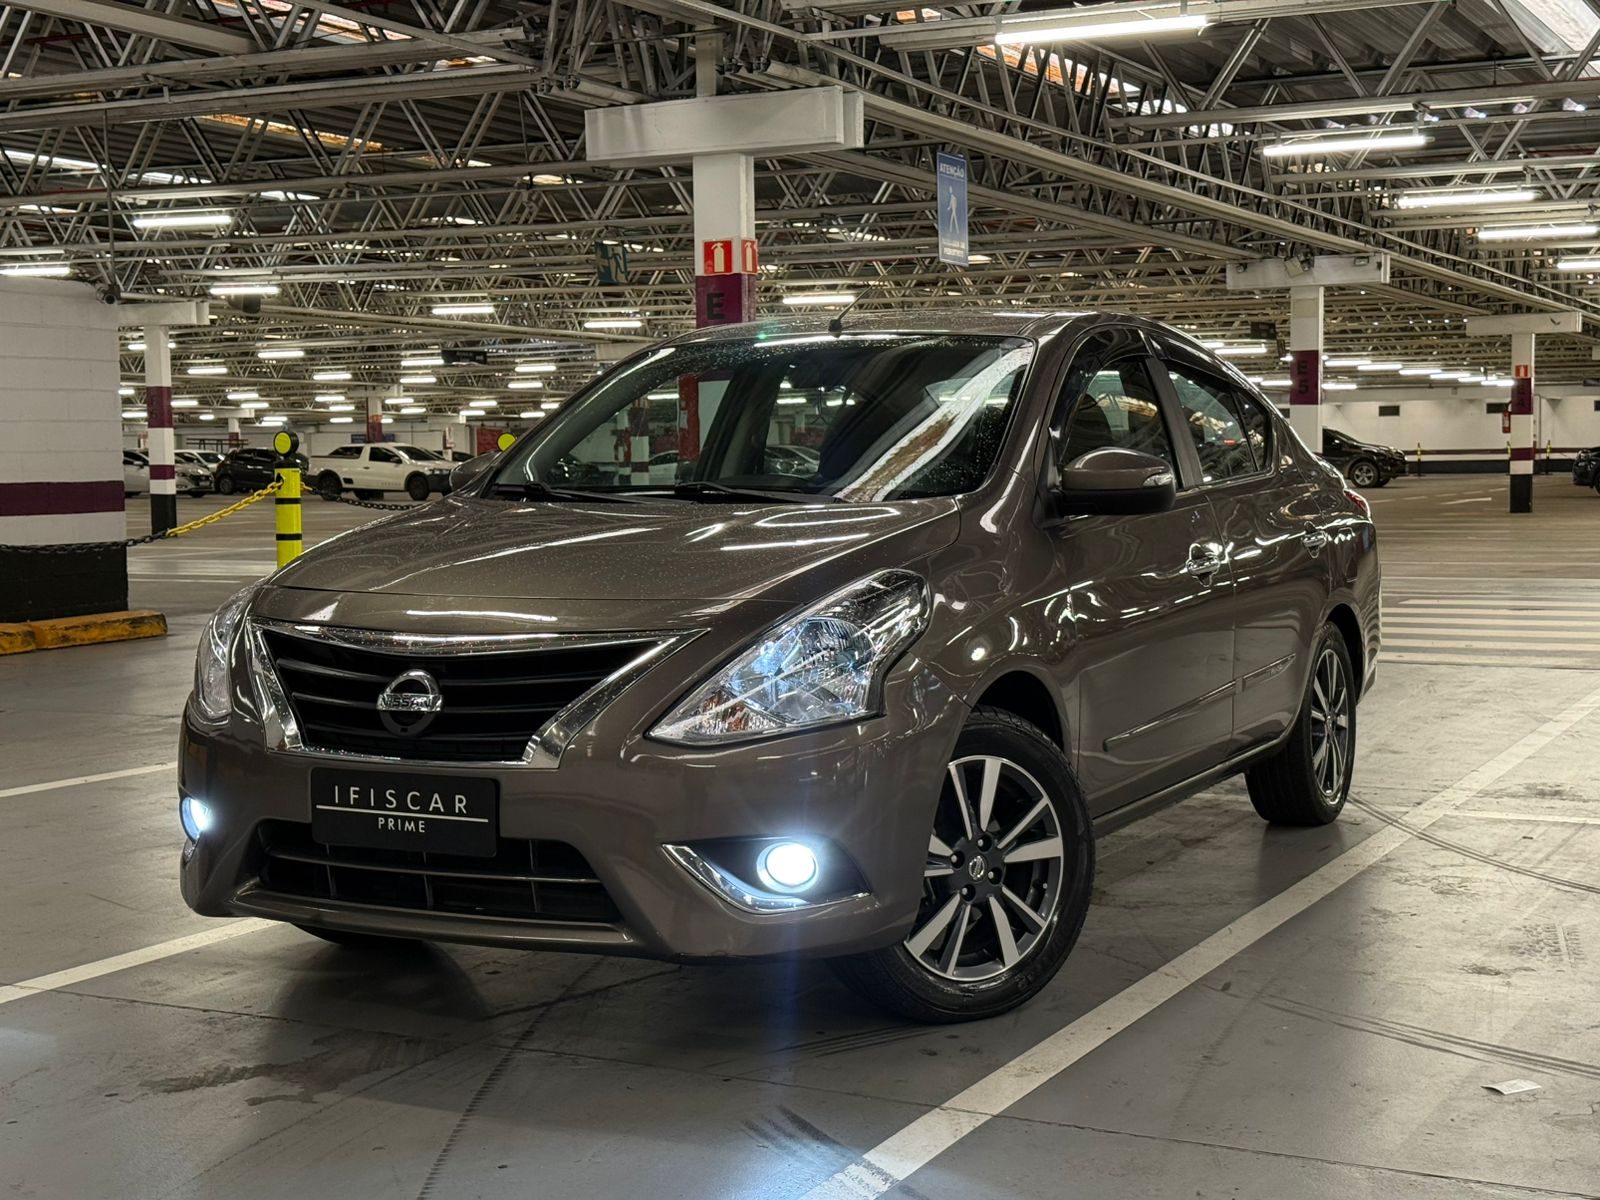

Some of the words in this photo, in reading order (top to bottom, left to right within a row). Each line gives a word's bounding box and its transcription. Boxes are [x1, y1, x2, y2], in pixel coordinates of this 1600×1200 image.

[939, 162, 965, 178] ATENÇÃO
[706, 292, 725, 320] E
[1297, 360, 1309, 375] E
[378, 695, 434, 710] NISSAN
[334, 785, 468, 815] IFISCAR
[378, 817, 426, 833] PRIME
